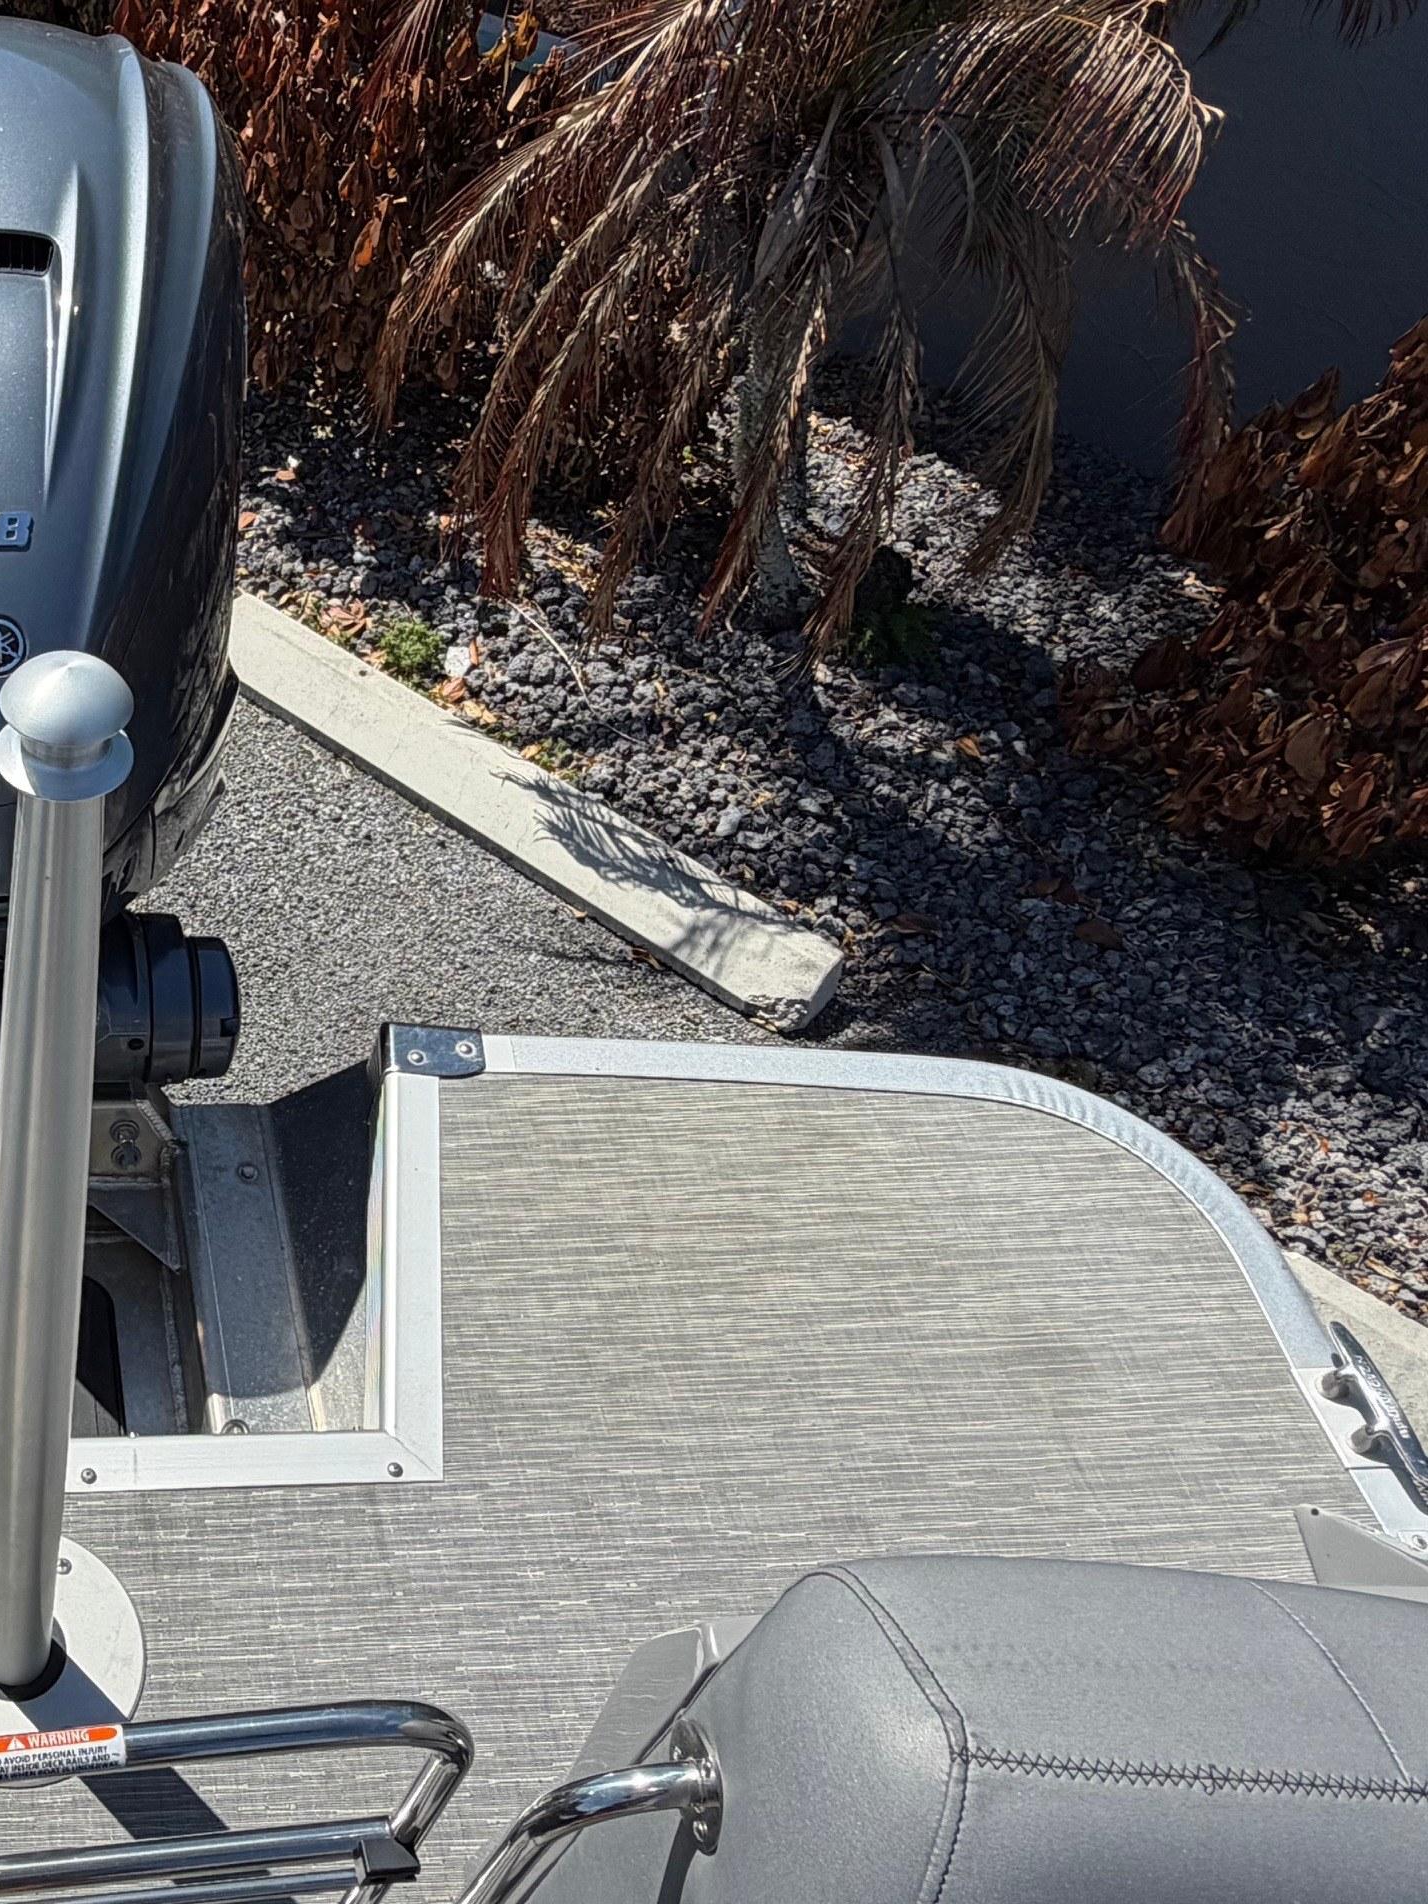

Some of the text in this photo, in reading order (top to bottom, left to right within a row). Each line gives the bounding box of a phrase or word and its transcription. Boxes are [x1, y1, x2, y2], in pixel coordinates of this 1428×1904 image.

[27, 1729, 90, 1748] WARNING
[4, 1754, 30, 1765] AVOID
[32, 1749, 76, 1761] PERSONAL
[78, 1745, 108, 1756] INJURY
[12, 1763, 40, 1772] INSIDE
[42, 1759, 65, 1769] DECK
[66, 1756, 90, 1766] RAILS
[92, 1753, 110, 1762] AND
